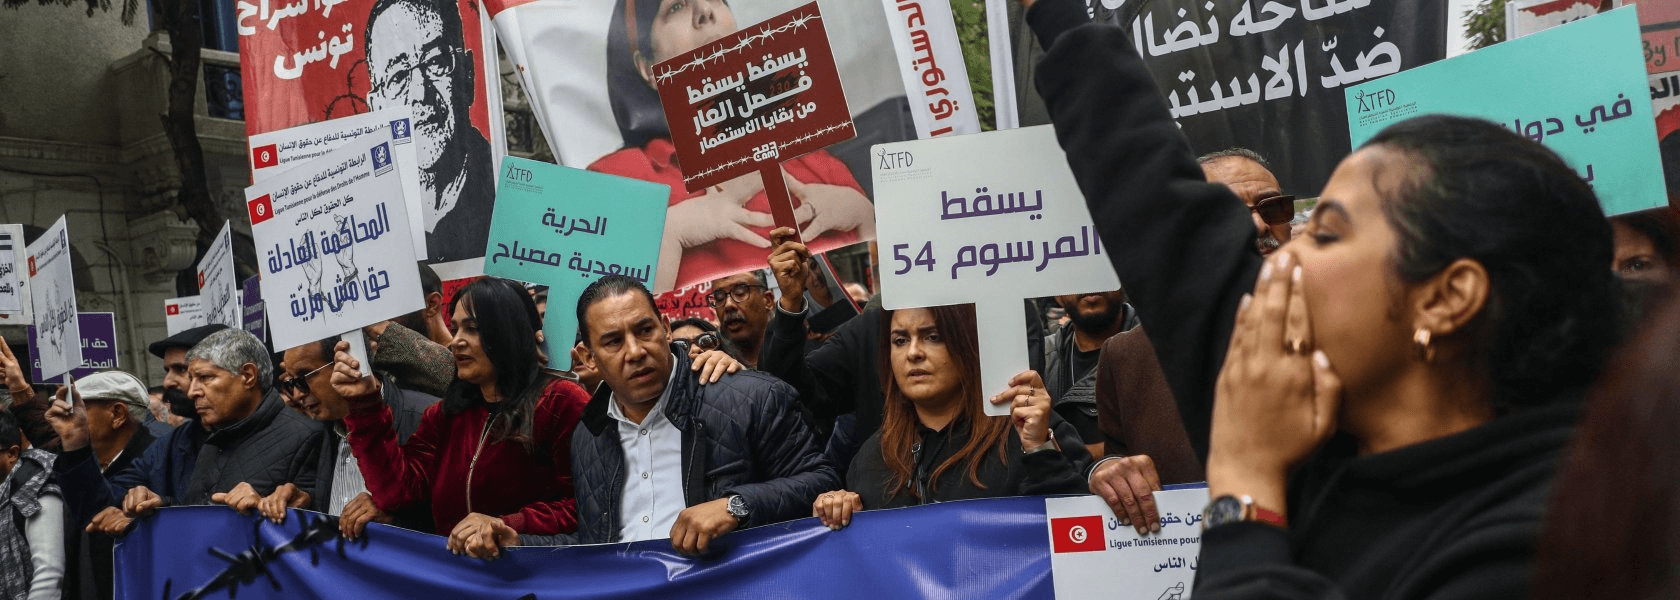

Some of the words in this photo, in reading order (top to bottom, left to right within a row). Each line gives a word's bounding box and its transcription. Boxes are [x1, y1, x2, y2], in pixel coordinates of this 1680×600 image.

[273, 23, 354, 80] تونس
[746, 47, 808, 82] يسقط
[896, 0, 960, 121] لدستوري
[686, 71, 745, 105] يسقط
[1355, 89, 1396, 113] ATFD
[692, 98, 735, 136] العار
[761, 107, 794, 131] بقايا
[796, 101, 817, 119] من
[1575, 93, 1633, 134] في
[313, 137, 323, 147] عن
[699, 117, 761, 155] الاستعمار
[1502, 117, 1564, 145] دول
[506, 162, 533, 182] ATFD
[877, 147, 914, 170] ATFD
[303, 179, 313, 190] عن
[940, 186, 1043, 221] يسقط
[321, 202, 390, 256] المحاكمة
[541, 207, 608, 237] الحرية
[267, 230, 319, 275] العادلة
[492, 240, 562, 267] مصباح
[568, 251, 652, 284] لسعدية
[893, 240, 936, 275] 54
[951, 224, 1102, 280] المرسوم
[326, 273, 360, 313] مش
[363, 266, 391, 302] حق
[79, 358, 114, 369] المحاك
[1160, 512, 1182, 528] حقو
[1185, 512, 1203, 526] عن
[1109, 539, 1132, 549] Ligue
[1133, 537, 1178, 547] Tunisienne
[1179, 536, 1200, 547] pour
[1153, 556, 1186, 573] الناس
